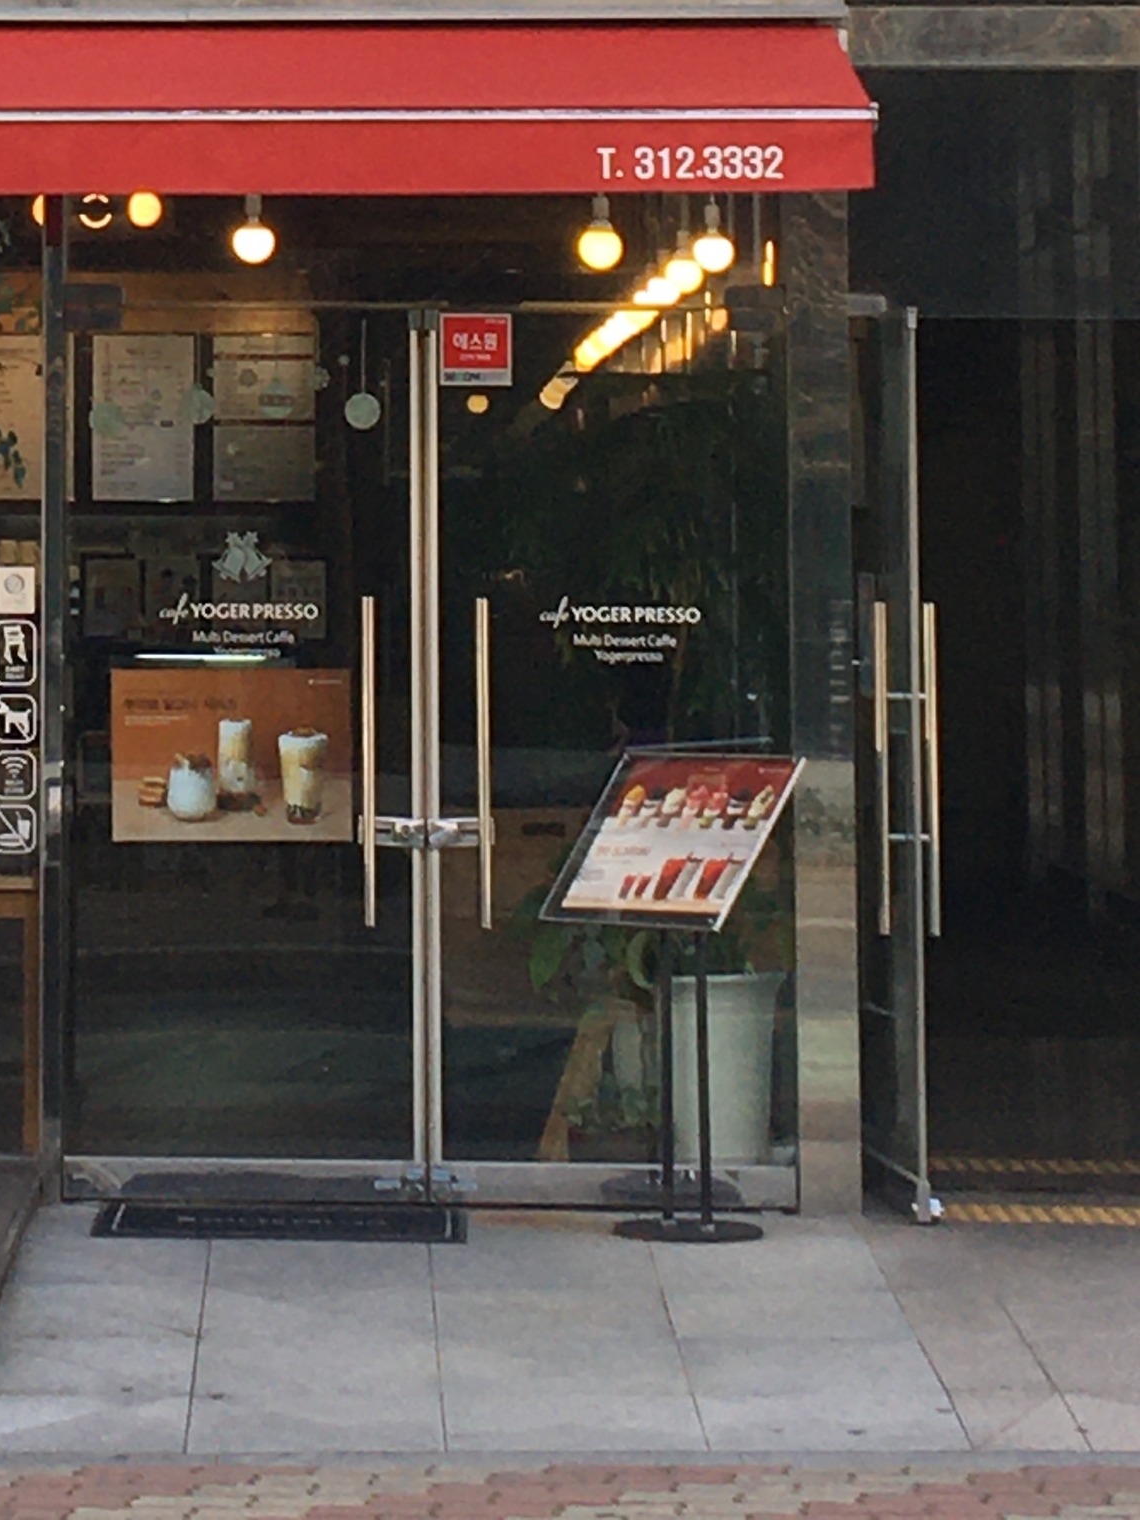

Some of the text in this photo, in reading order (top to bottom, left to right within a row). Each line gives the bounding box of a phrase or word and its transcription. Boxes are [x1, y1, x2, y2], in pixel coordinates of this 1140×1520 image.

[596, 146, 785, 179] T. 312.3332
[190, 602, 250, 620] YOGER
[252, 602, 319, 620] PRESSO
[571, 606, 632, 624] YOGER
[634, 606, 702, 624] PRESSO
